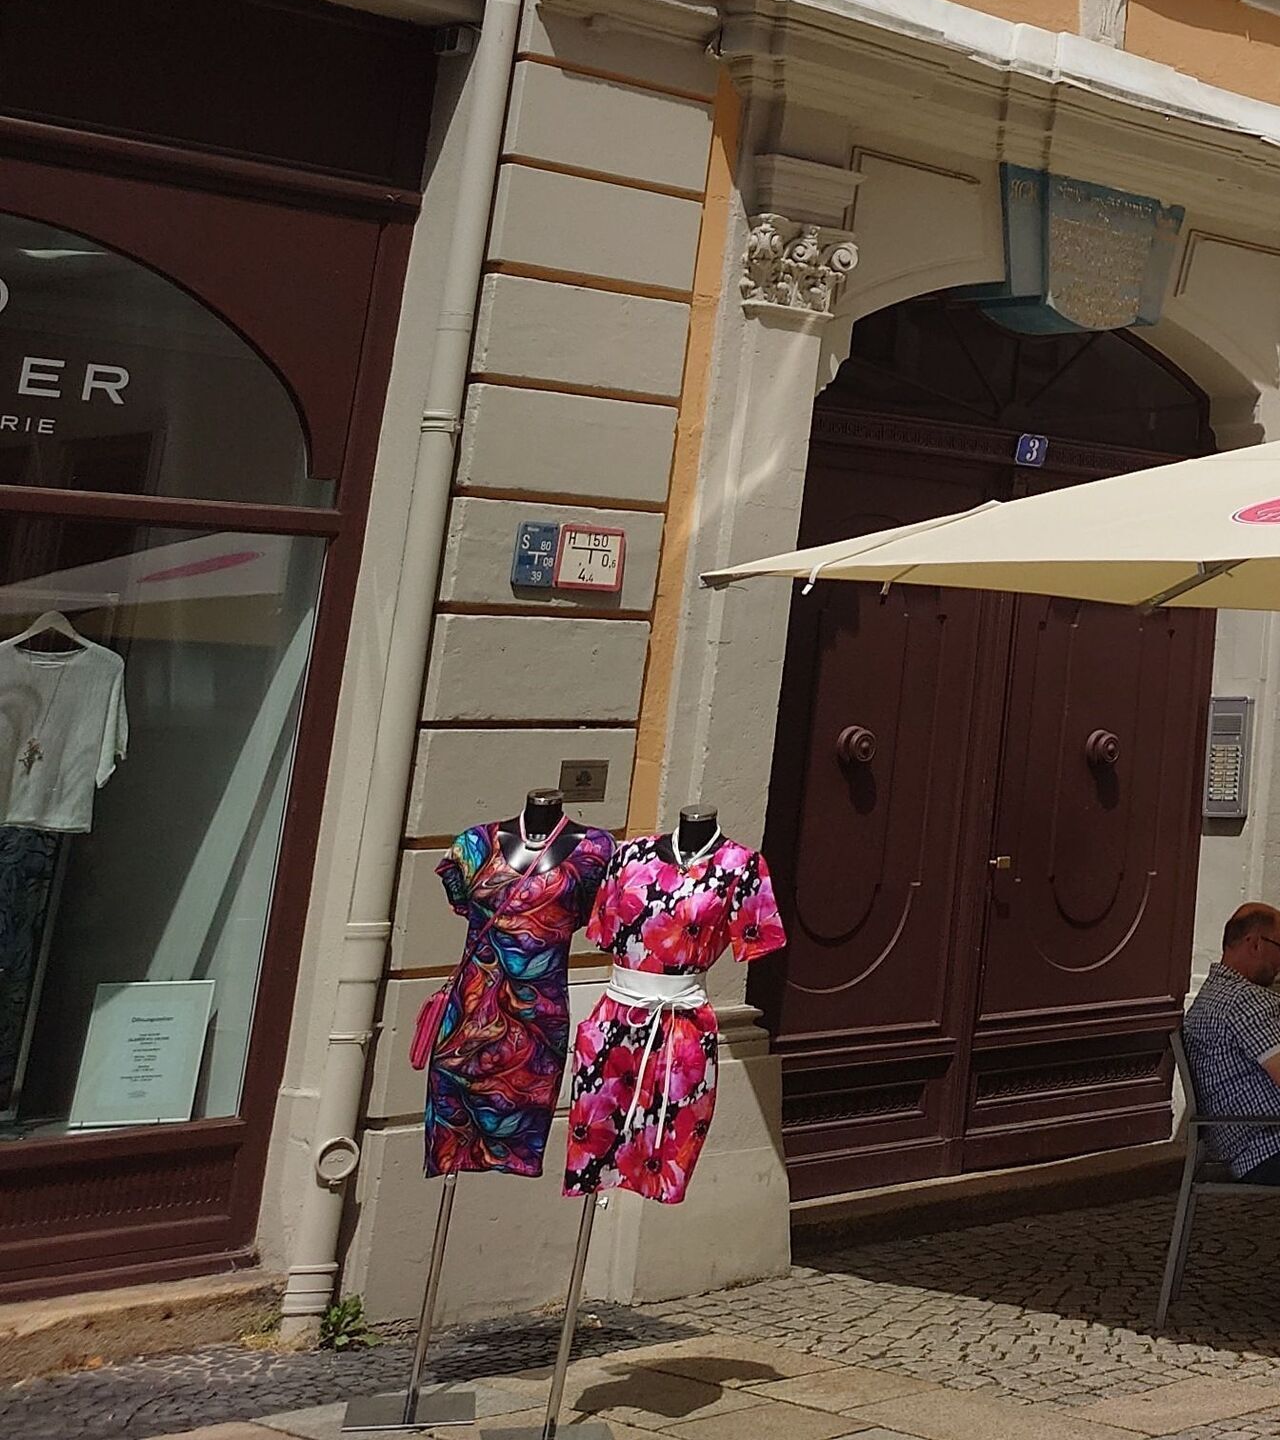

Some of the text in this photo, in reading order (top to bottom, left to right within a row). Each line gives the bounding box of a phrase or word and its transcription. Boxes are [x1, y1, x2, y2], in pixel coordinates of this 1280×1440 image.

[18, 356, 130, 404] ER
[1, 415, 56, 434] RIE
[1026, 439, 1040, 462] 3
[521, 533, 531, 549] S
[568, 531, 610, 548] H 150
